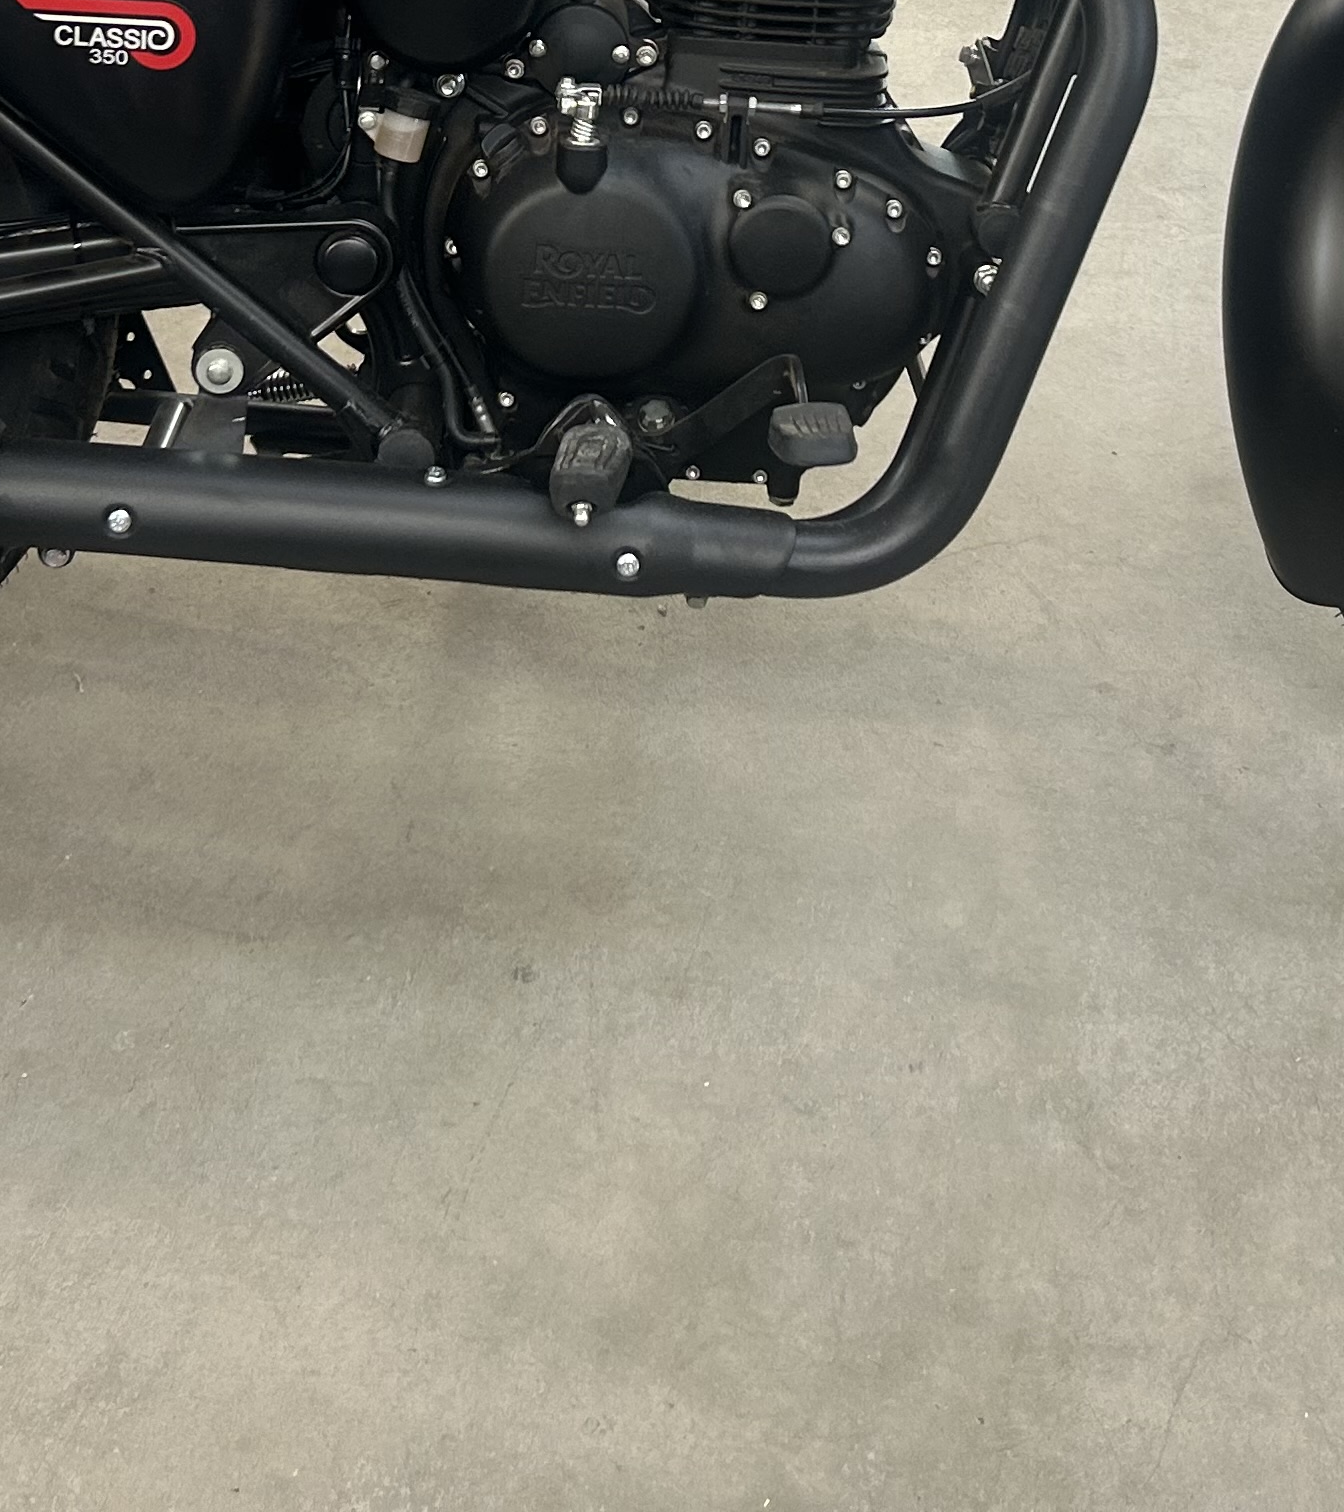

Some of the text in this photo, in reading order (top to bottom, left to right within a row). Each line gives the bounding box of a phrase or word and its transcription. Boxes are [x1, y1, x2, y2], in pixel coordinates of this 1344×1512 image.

[54, 21, 175, 51] CLASSIC
[88, 48, 129, 66] 350
[534, 243, 643, 281] ROYAL
[520, 276, 657, 316] ENFIELD
